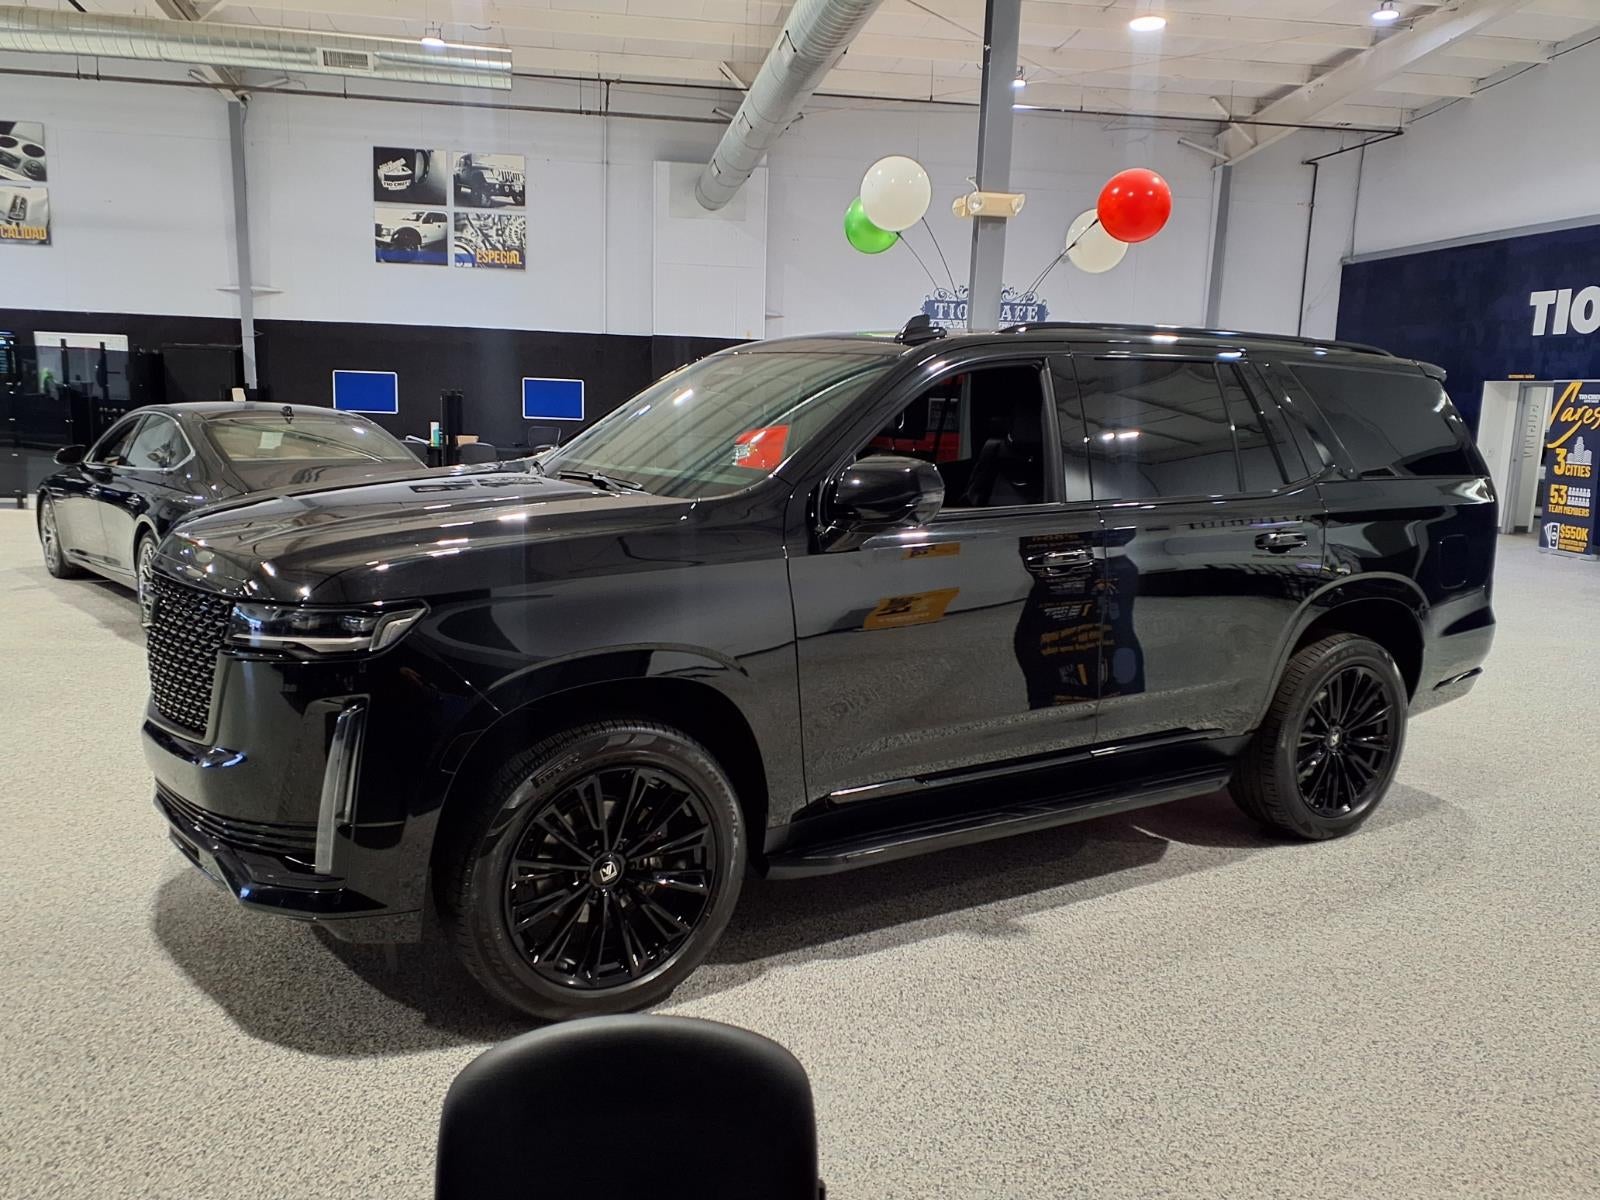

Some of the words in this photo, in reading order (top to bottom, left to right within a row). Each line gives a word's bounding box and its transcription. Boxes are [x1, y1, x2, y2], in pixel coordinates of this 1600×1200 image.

[0, 224, 47, 240] CALIDAD
[476, 248, 522, 265] ESPECIAL
[1000, 304, 1038, 322] AFE
[1529, 285, 1600, 336] TIO
[1553, 448, 1567, 475] 3
[1565, 464, 1591, 478] CITIES
[1550, 483, 1568, 505] 53
[1548, 504, 1564, 515] TEAM
[1563, 506, 1590, 518] MEMBERS
[1559, 522, 1589, 542] $550K
